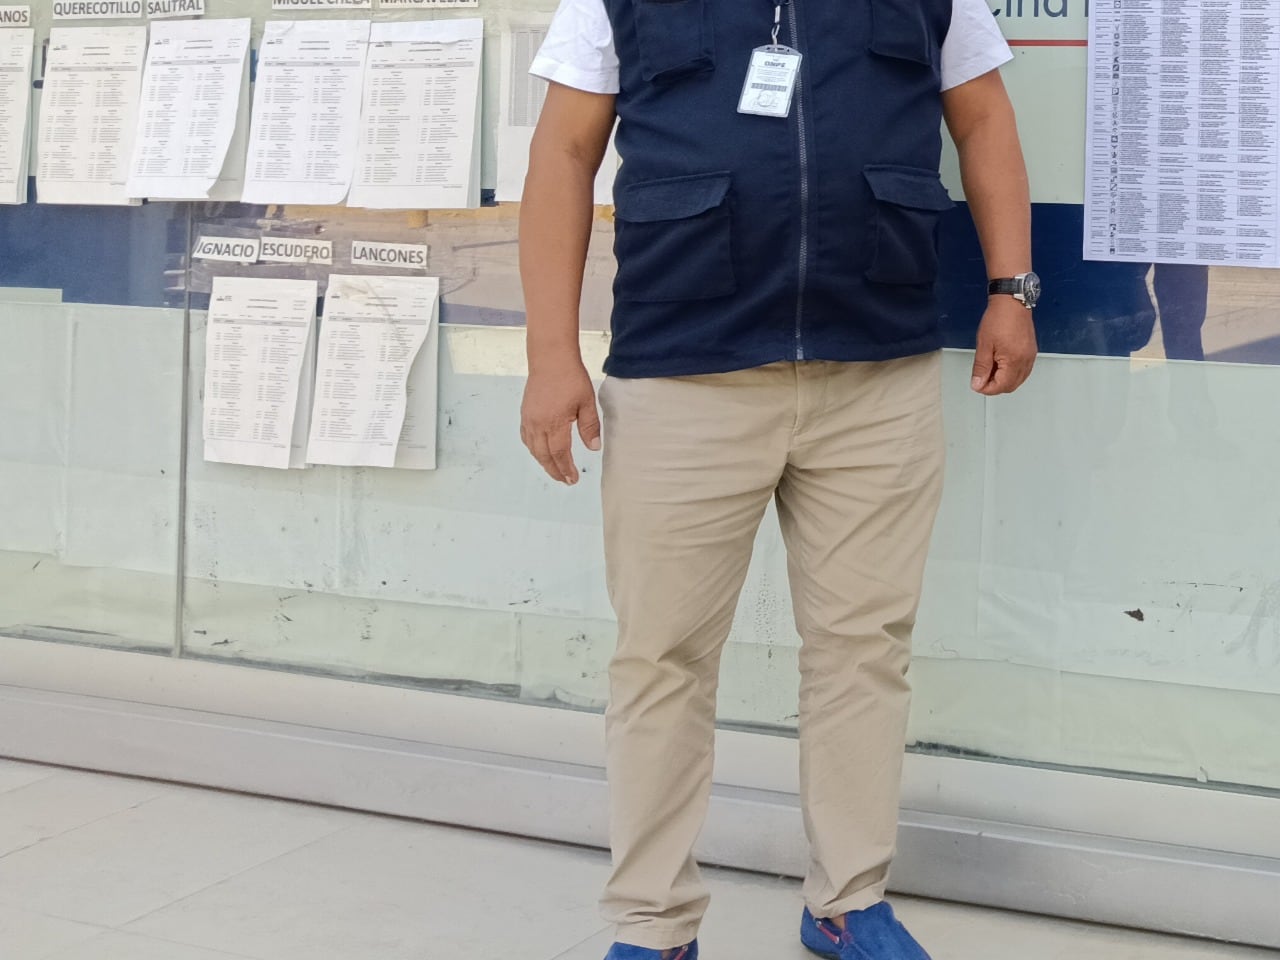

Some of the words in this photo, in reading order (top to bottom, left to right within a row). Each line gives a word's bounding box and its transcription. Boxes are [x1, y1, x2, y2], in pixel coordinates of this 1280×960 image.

[54, 0, 141, 16] QUERECOTILLO
[197, 243, 254, 258] IGNACIO
[262, 245, 330, 259] ESCUDERO
[353, 246, 424, 264] LANCONES
